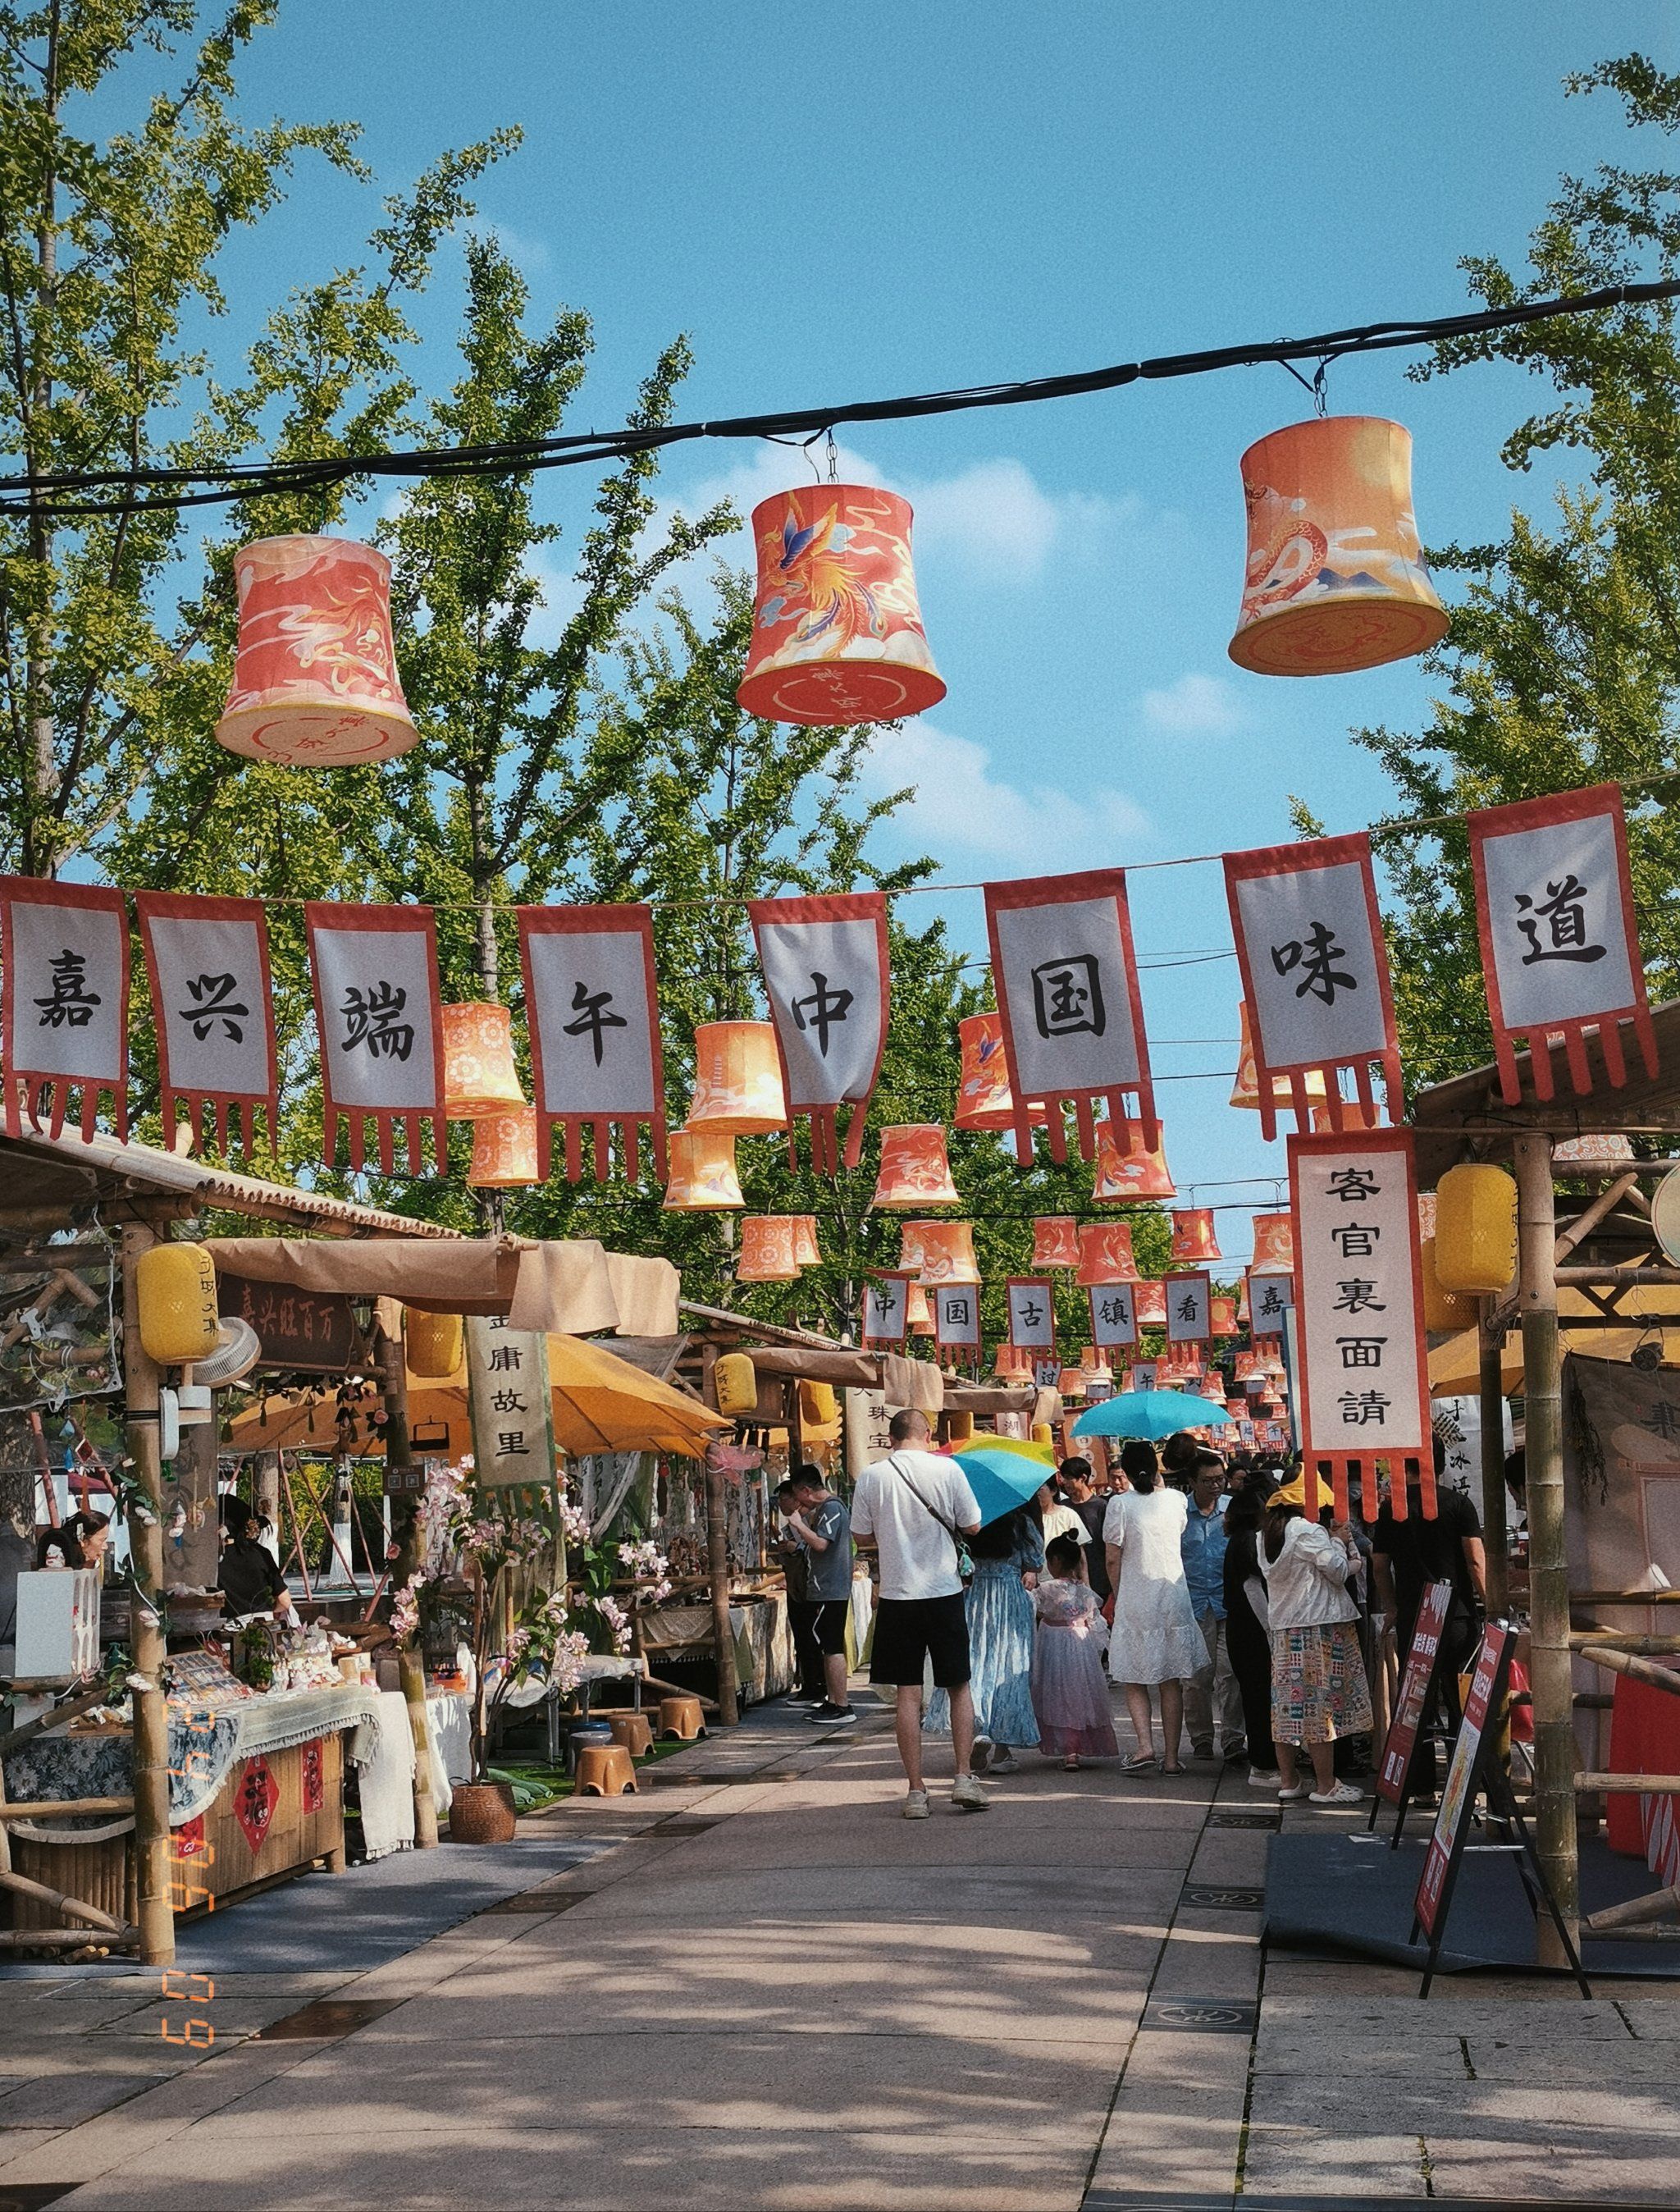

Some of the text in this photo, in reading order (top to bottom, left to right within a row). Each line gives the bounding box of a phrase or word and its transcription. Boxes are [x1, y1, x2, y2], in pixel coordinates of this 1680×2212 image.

[1514, 875, 1608, 966] 道
[33, 948, 102, 1028] 嘉
[1030, 953, 1107, 1039] 国
[1271, 921, 1358, 1006] 味
[179, 973, 249, 1044] 兴
[340, 981, 415, 1062] 端
[564, 982, 628, 1067] 午
[790, 972, 853, 1058] 中
[874, 1297, 897, 1322] 中
[945, 1299, 970, 1327] 国
[1018, 1300, 1044, 1328] 古
[1098, 1299, 1130, 1327] 镇
[1177, 1294, 1198, 1322] 看
[1259, 1286, 1284, 1316] 嘉
[1325, 1168, 1392, 1427] 客官裏面請
[1041, 1371, 1058, 1387] 过
[1140, 1373, 1154, 1389] 午
